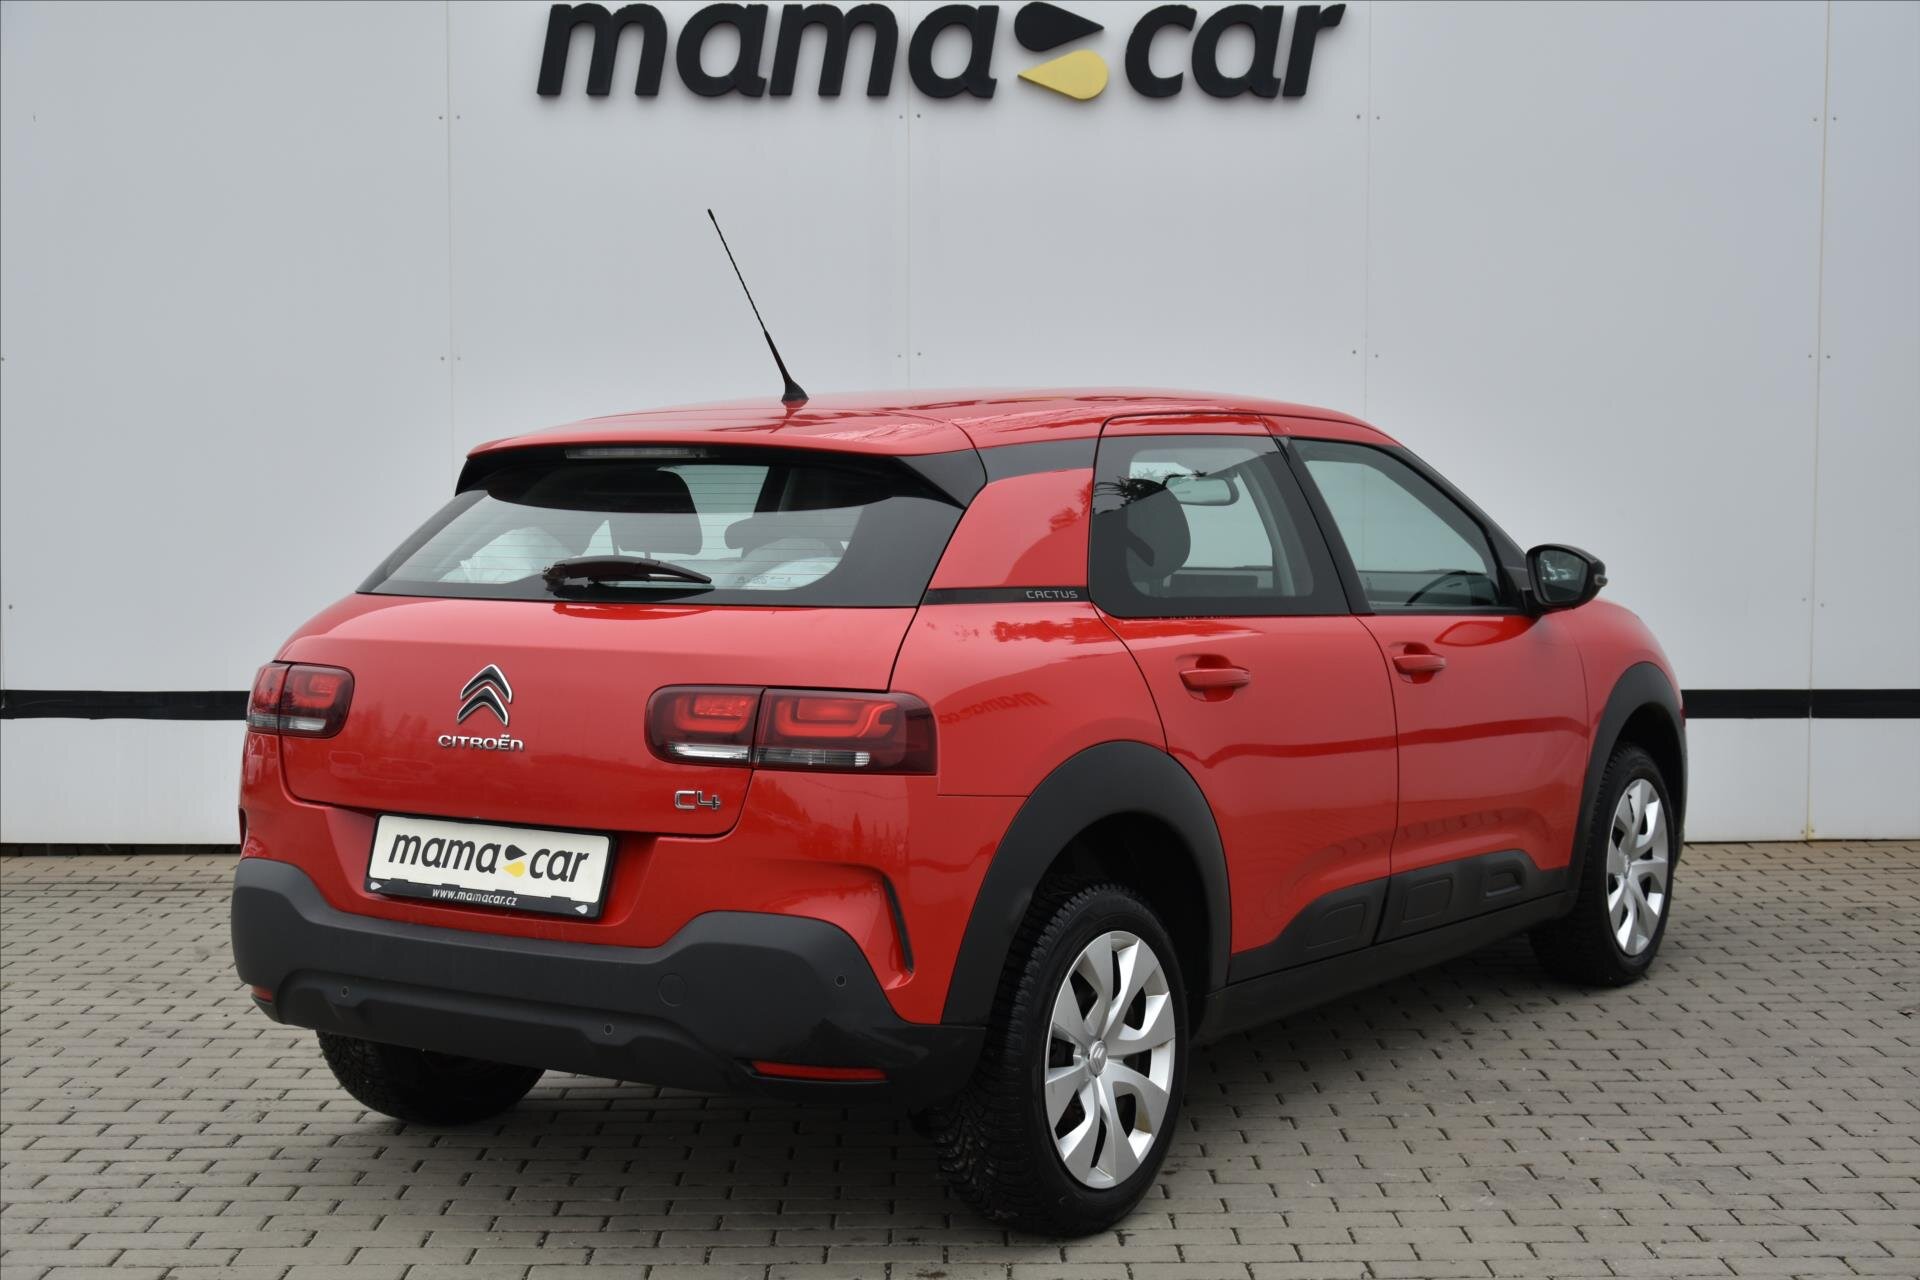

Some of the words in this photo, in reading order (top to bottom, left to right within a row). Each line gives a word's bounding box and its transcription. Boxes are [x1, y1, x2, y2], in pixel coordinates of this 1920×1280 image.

[537, 3, 999, 99] mama
[1125, 4, 1346, 99] car
[1026, 590, 1078, 599] CACTUS
[674, 790, 720, 810] C4
[388, 834, 501, 874] mama
[529, 848, 589, 883] car
[432, 888, 518, 906] www.mamacar.cz
